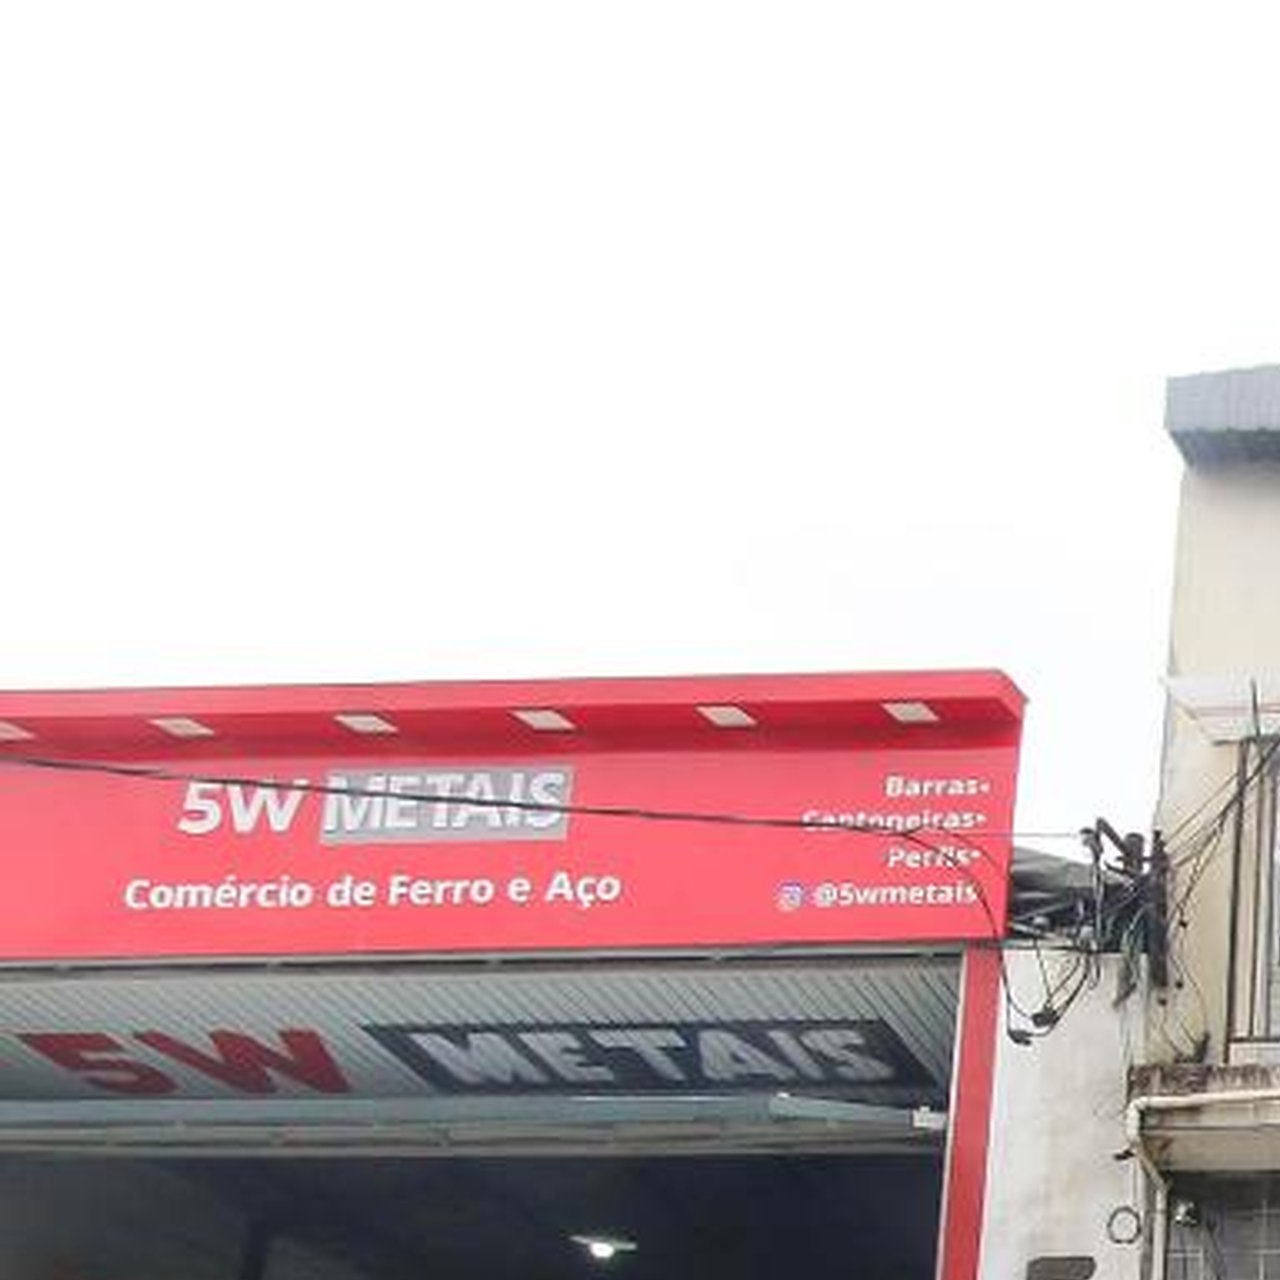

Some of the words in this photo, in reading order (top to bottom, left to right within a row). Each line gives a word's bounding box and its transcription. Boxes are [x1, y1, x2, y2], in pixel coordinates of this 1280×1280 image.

[178, 780, 306, 834] 5W
[322, 773, 565, 831] METAIS
[885, 776, 977, 797] Barras
[125, 873, 313, 909] Comércio
[327, 874, 376, 907] de
[388, 873, 494, 906] Ferro
[507, 879, 530, 902] e
[545, 871, 621, 909] Aço
[18, 1031, 350, 1094] 5W
[408, 1028, 892, 1086] METAIS
